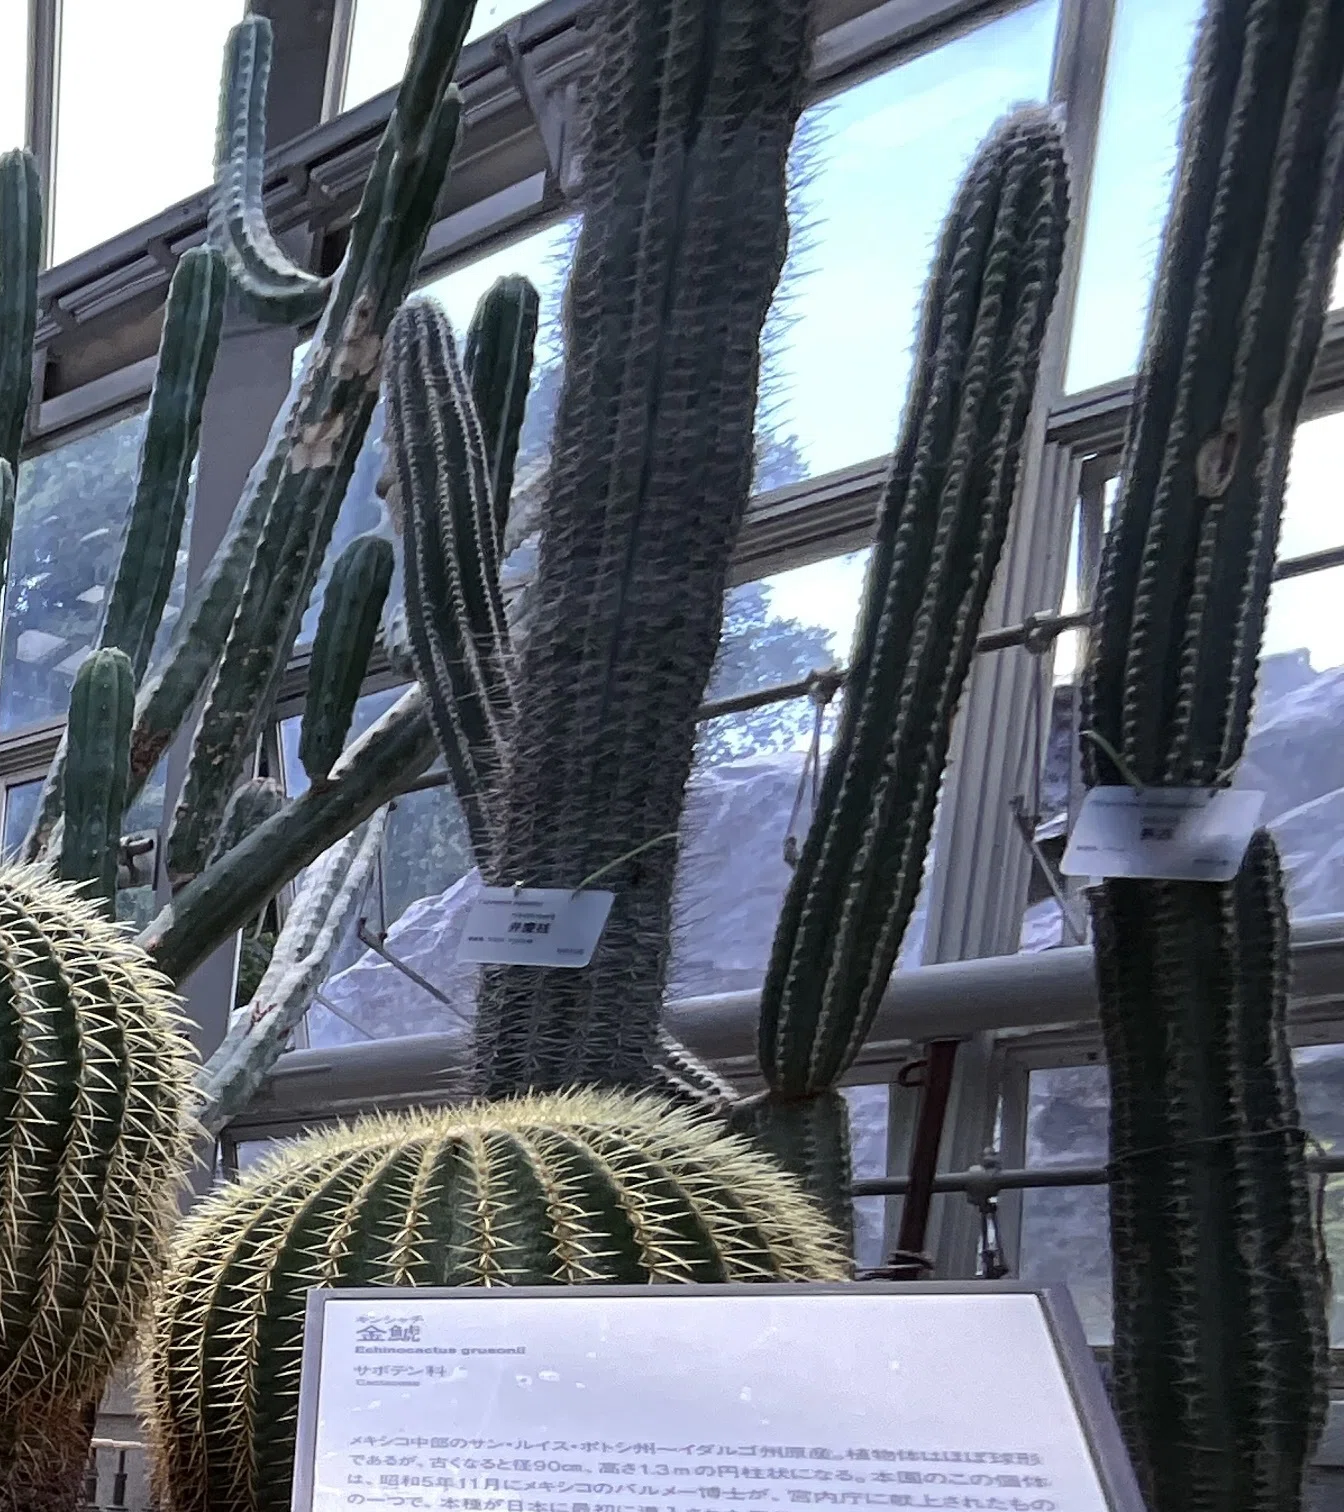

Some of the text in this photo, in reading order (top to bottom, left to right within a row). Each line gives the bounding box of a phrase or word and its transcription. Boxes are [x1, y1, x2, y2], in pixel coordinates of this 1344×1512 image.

[355, 1325, 421, 1342] 金鯱
[355, 1346, 457, 1354] Echinocactus
[354, 1365, 447, 1377] サボテン科
